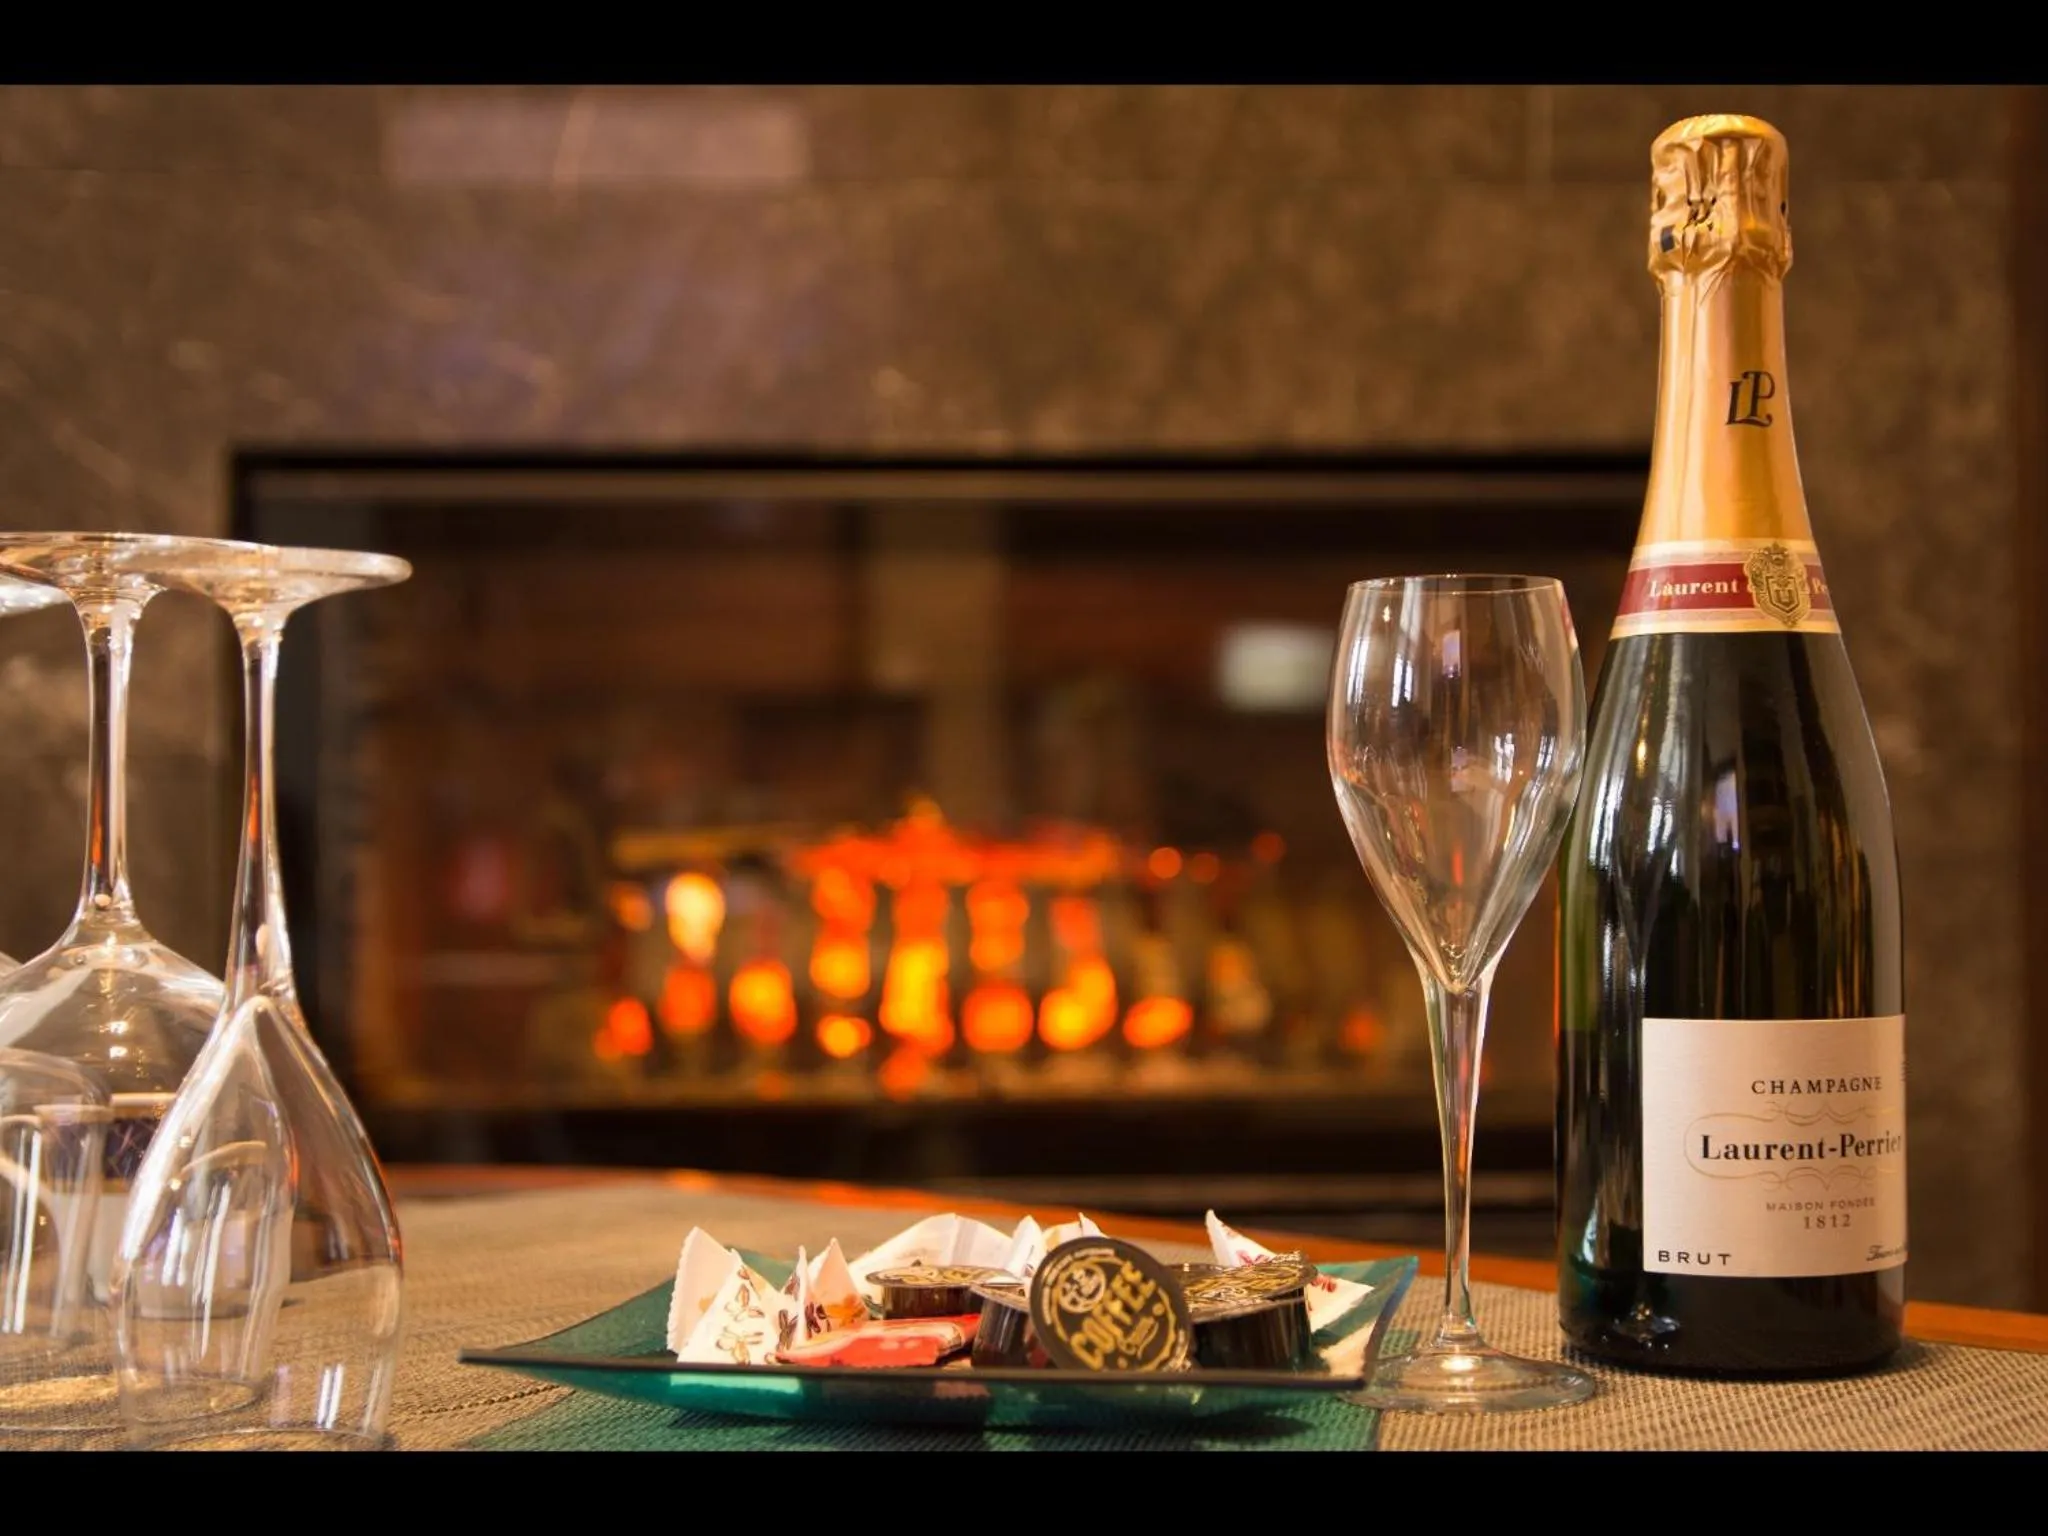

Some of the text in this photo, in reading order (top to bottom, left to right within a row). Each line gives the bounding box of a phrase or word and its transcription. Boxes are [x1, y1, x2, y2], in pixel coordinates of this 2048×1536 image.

[1649, 575, 1738, 598] Laurent
[1751, 1076, 1882, 1095] CHAMPAGNE
[1766, 1200, 1824, 1212] MAISON
[1803, 1213, 1852, 1230] 1812
[1658, 1250, 1732, 1266] BRUT
[1070, 1260, 1157, 1371] COFFEE
